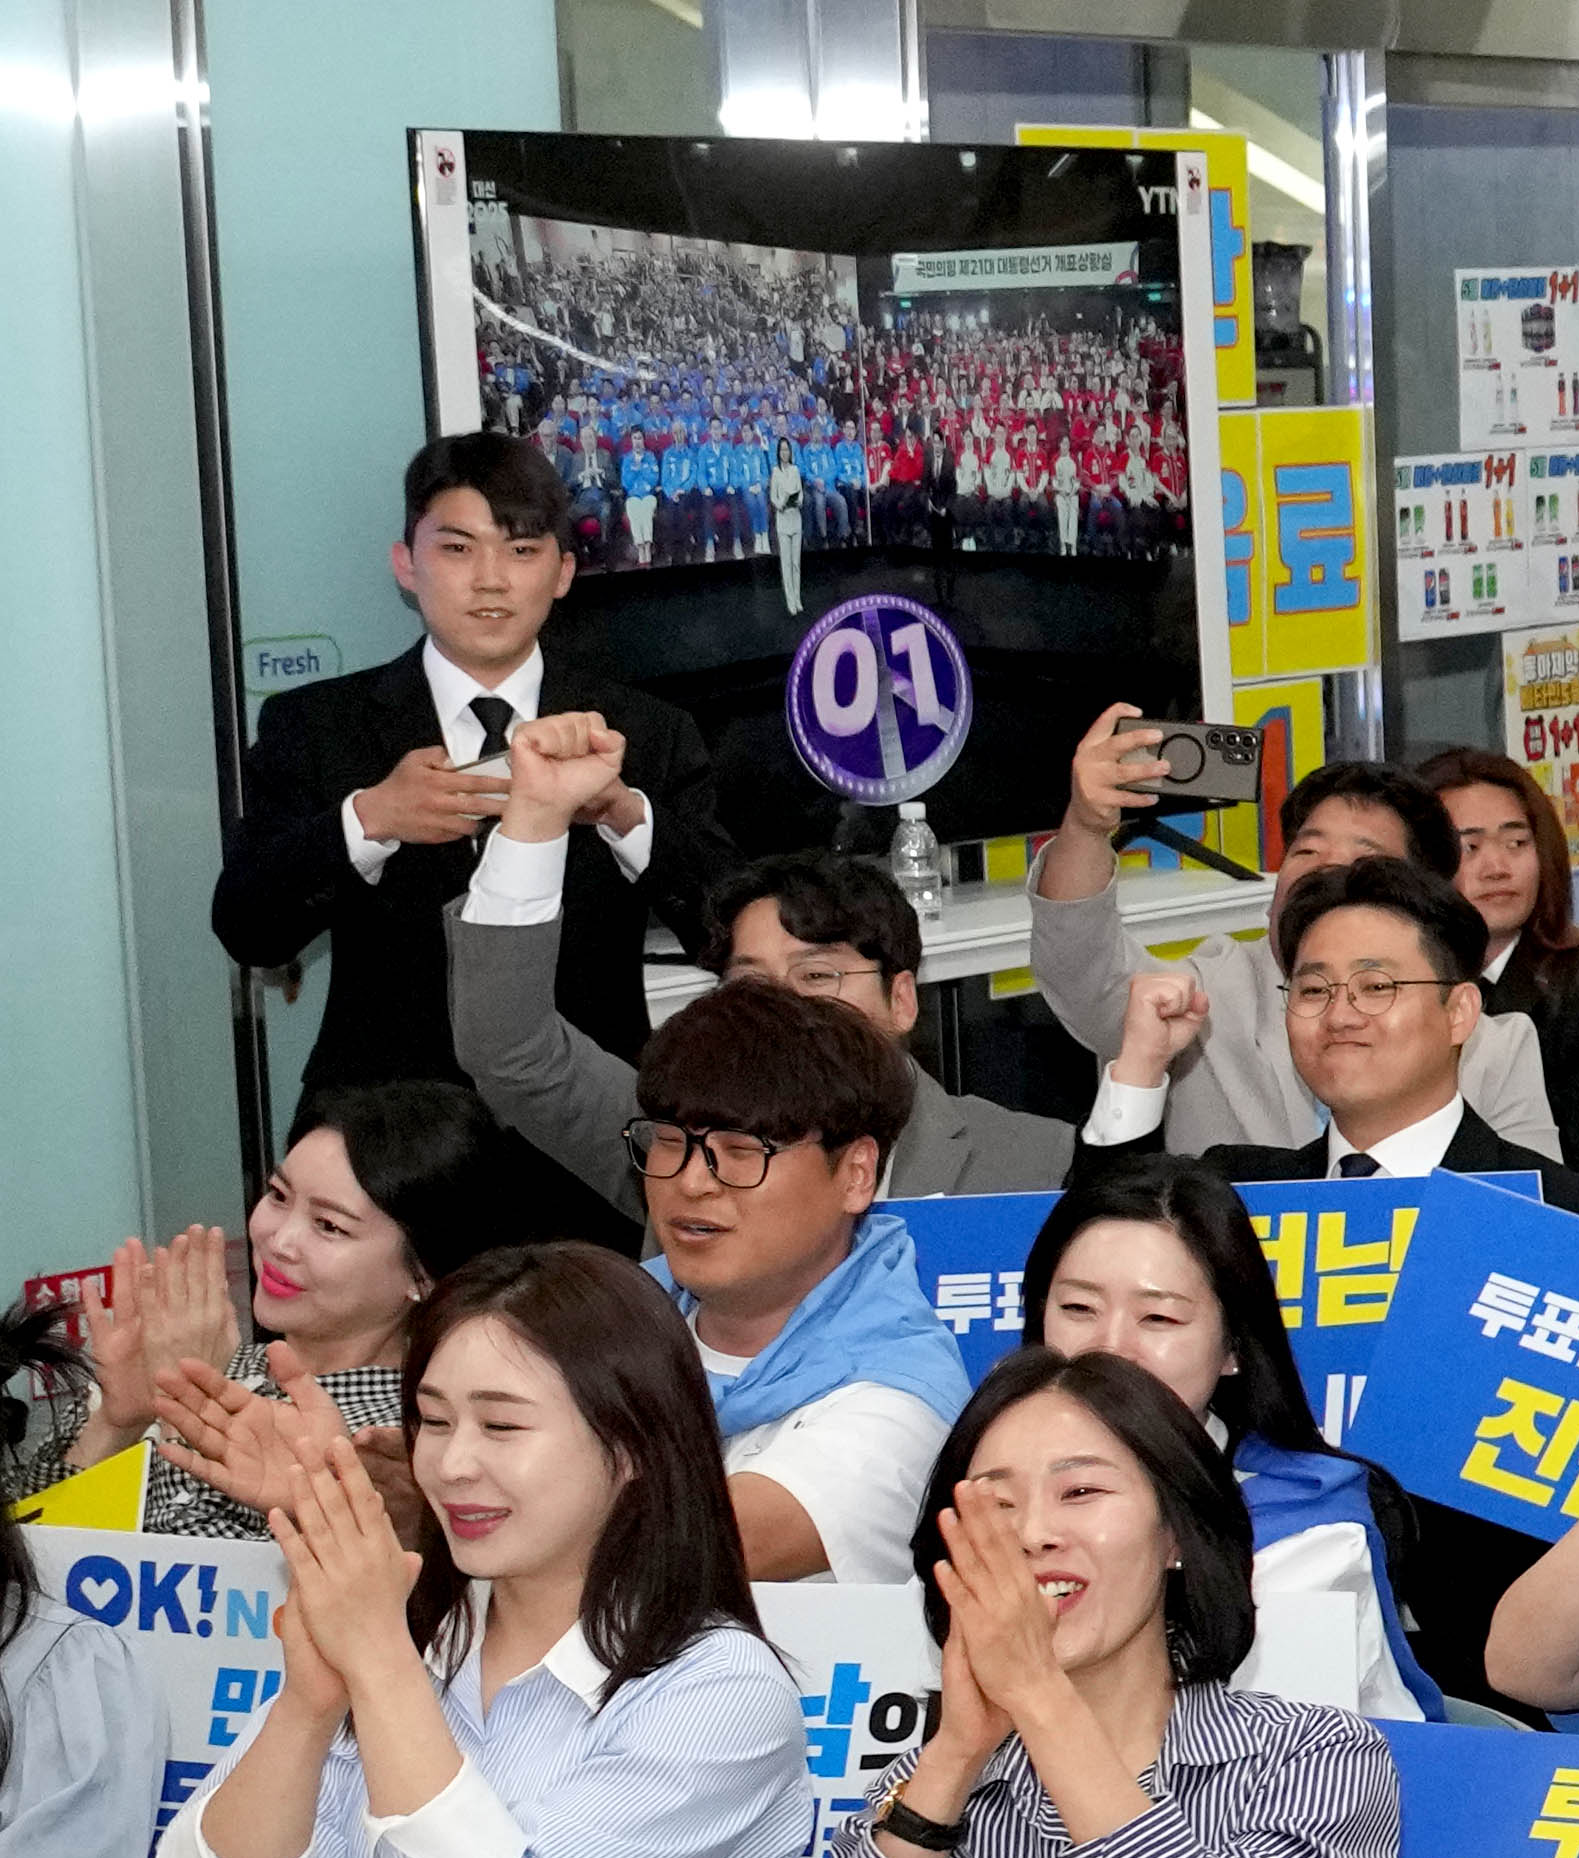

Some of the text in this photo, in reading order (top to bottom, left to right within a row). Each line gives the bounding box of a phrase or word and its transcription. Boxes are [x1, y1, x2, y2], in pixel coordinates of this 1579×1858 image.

[259, 648, 320, 677] Fresh
[812, 623, 941, 737] 01
[65, 1555, 218, 1638] OK!
